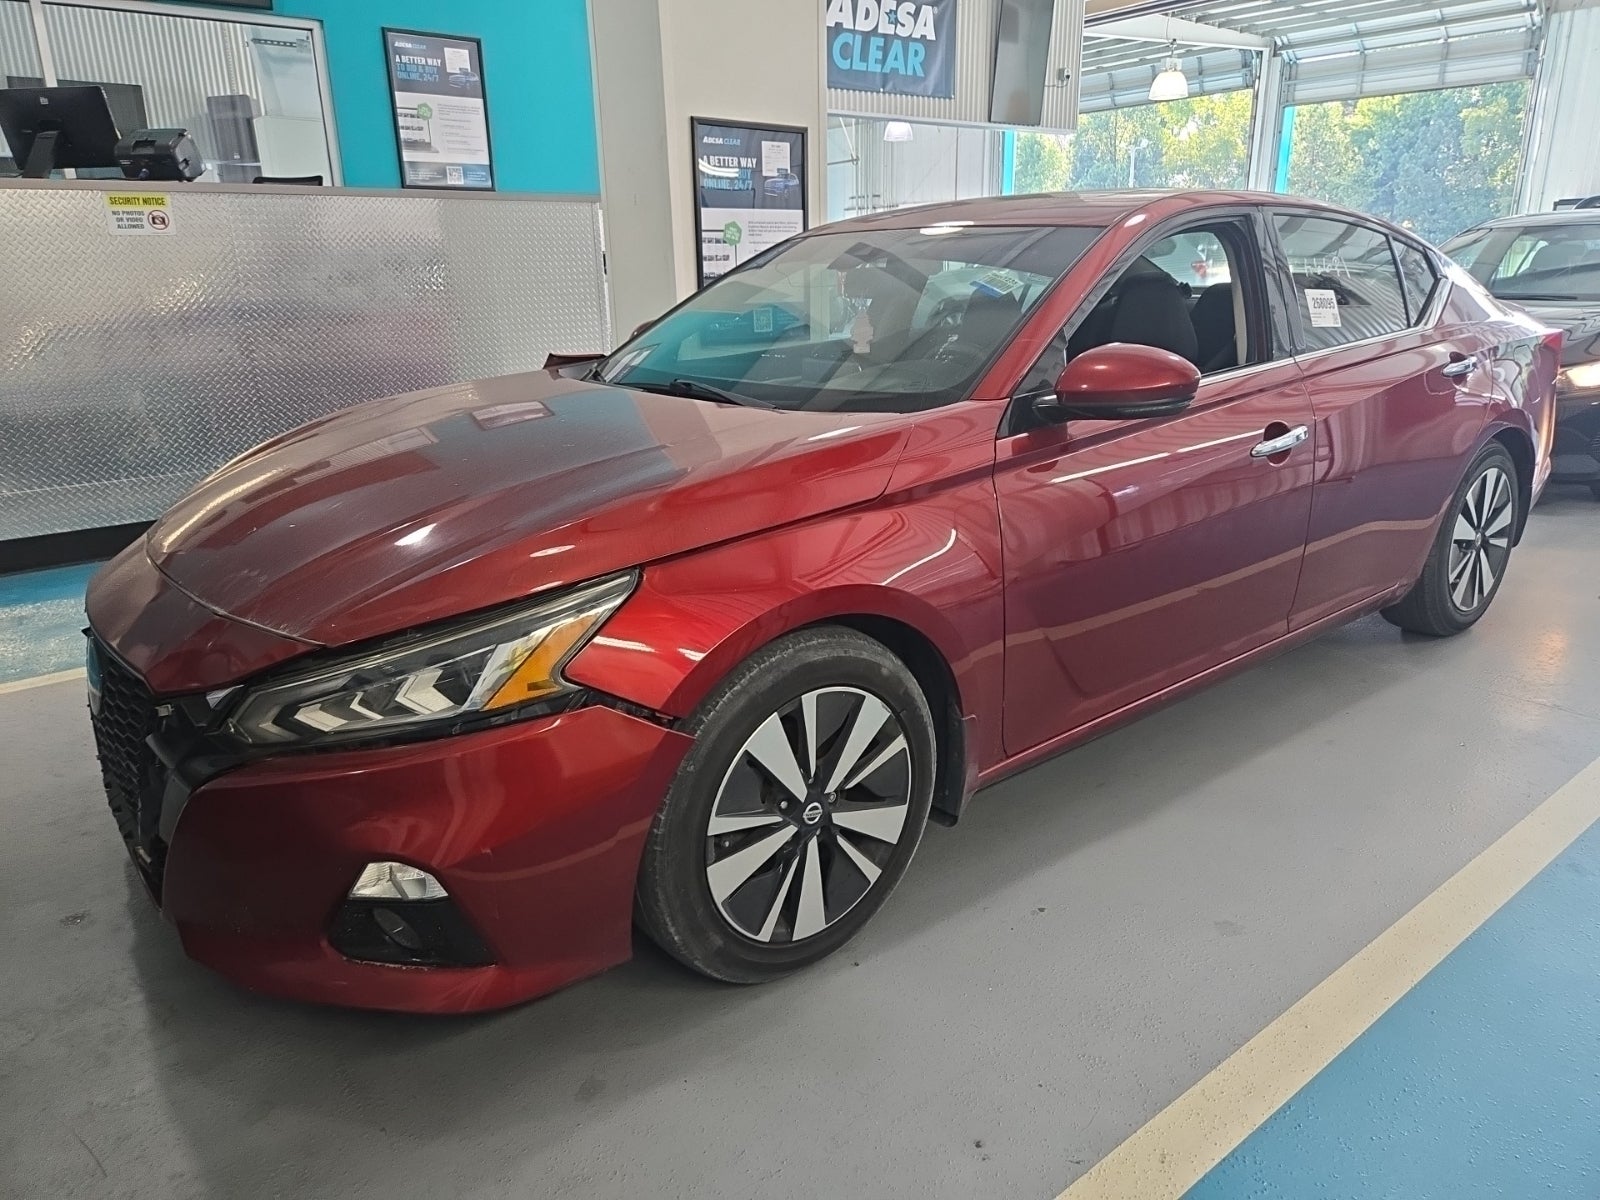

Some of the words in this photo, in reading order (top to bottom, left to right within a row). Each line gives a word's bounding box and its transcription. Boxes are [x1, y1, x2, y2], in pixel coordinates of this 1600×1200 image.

[826, 0, 937, 41] ADESA
[395, 54, 401, 63] A
[401, 55, 426, 65] BETTER
[427, 57, 441, 67] WAY
[832, 31, 925, 77] CLEAR
[709, 155, 739, 167] BETTER
[740, 157, 757, 168] WAY
[109, 197, 140, 205] SECURITY
[142, 197, 165, 205] NOTICE
